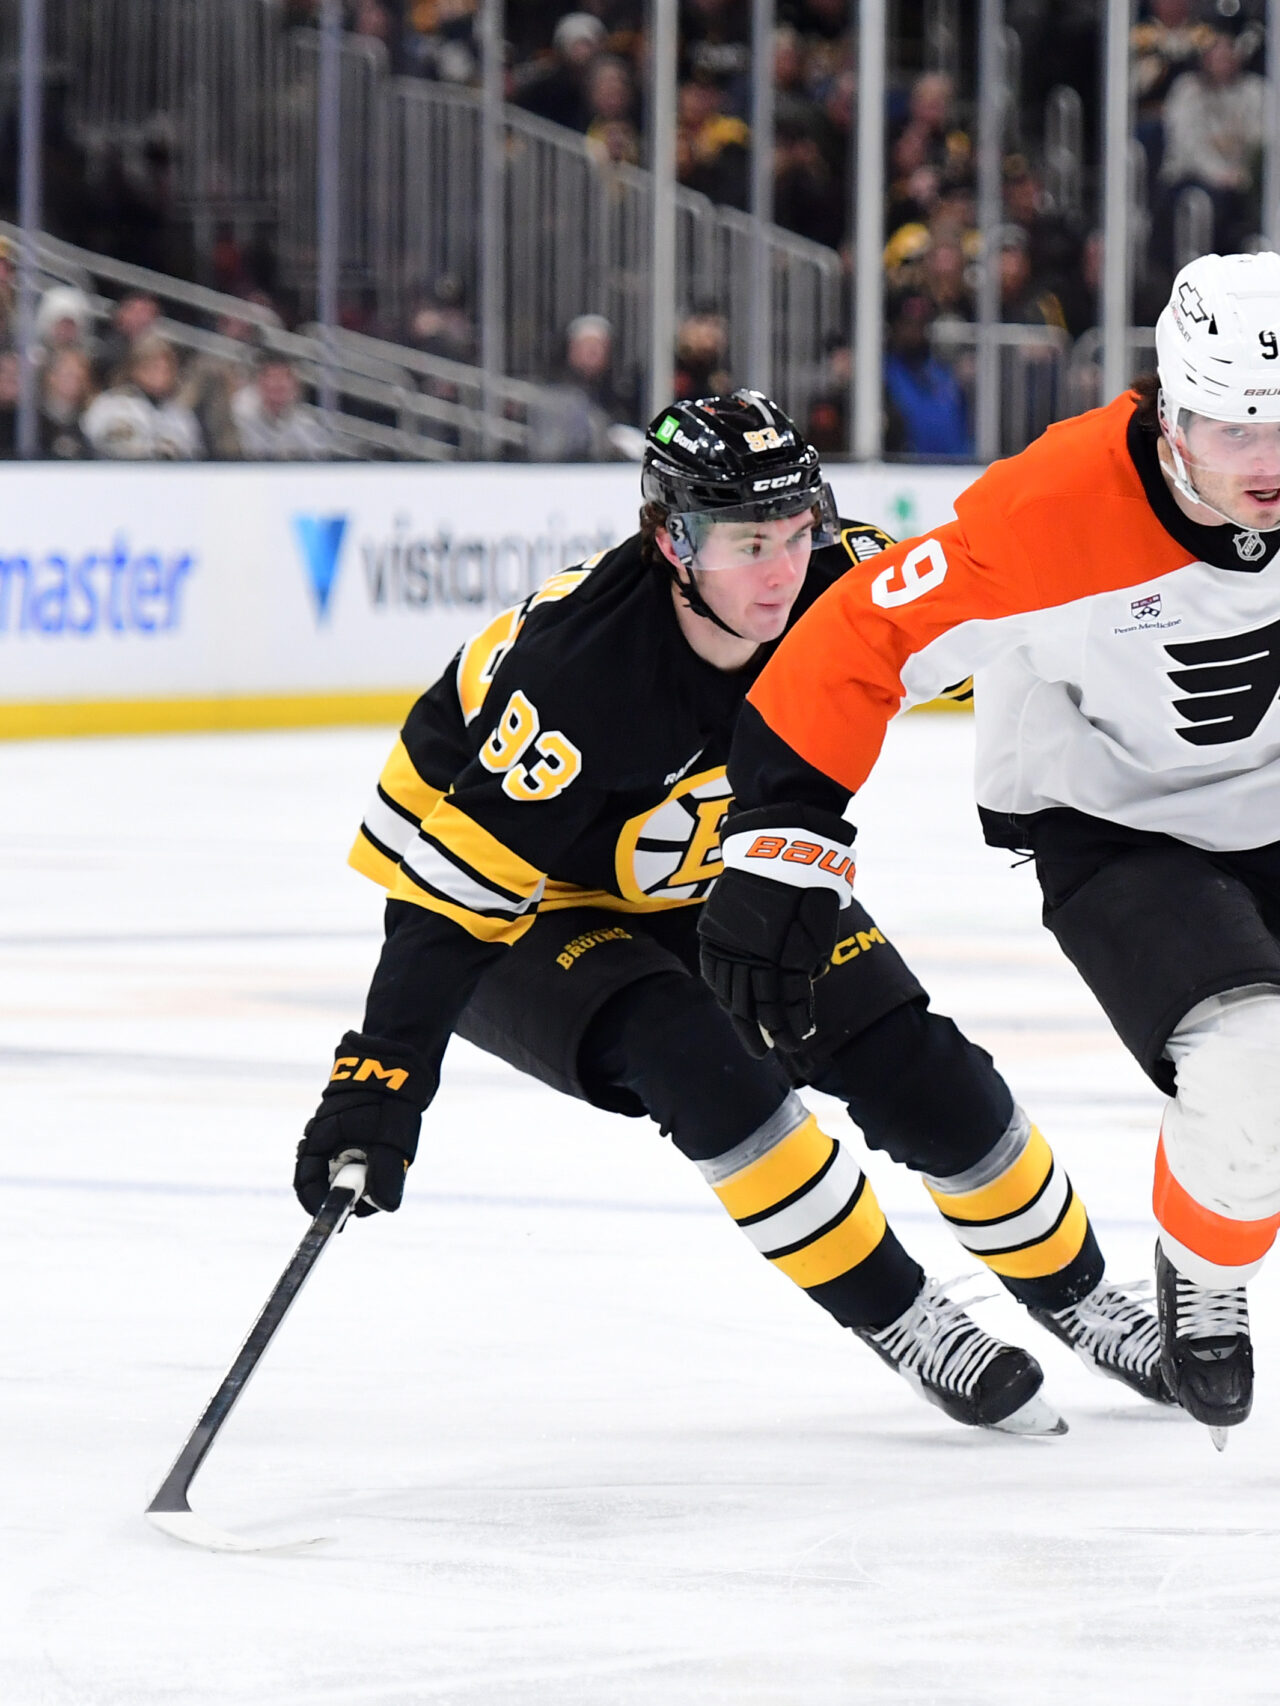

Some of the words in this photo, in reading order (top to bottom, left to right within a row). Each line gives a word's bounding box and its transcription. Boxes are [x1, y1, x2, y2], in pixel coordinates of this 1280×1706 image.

[1258, 329, 1279, 361] 9
[672, 429, 700, 455] Bank
[742, 426, 784, 453] 93
[752, 471, 802, 492] CCM
[871, 537, 948, 609] 9
[1114, 626, 1137, 635] Penn
[1138, 618, 1182, 631] Medicine
[478, 689, 582, 801] 93
[823, 927, 887, 976] CM
